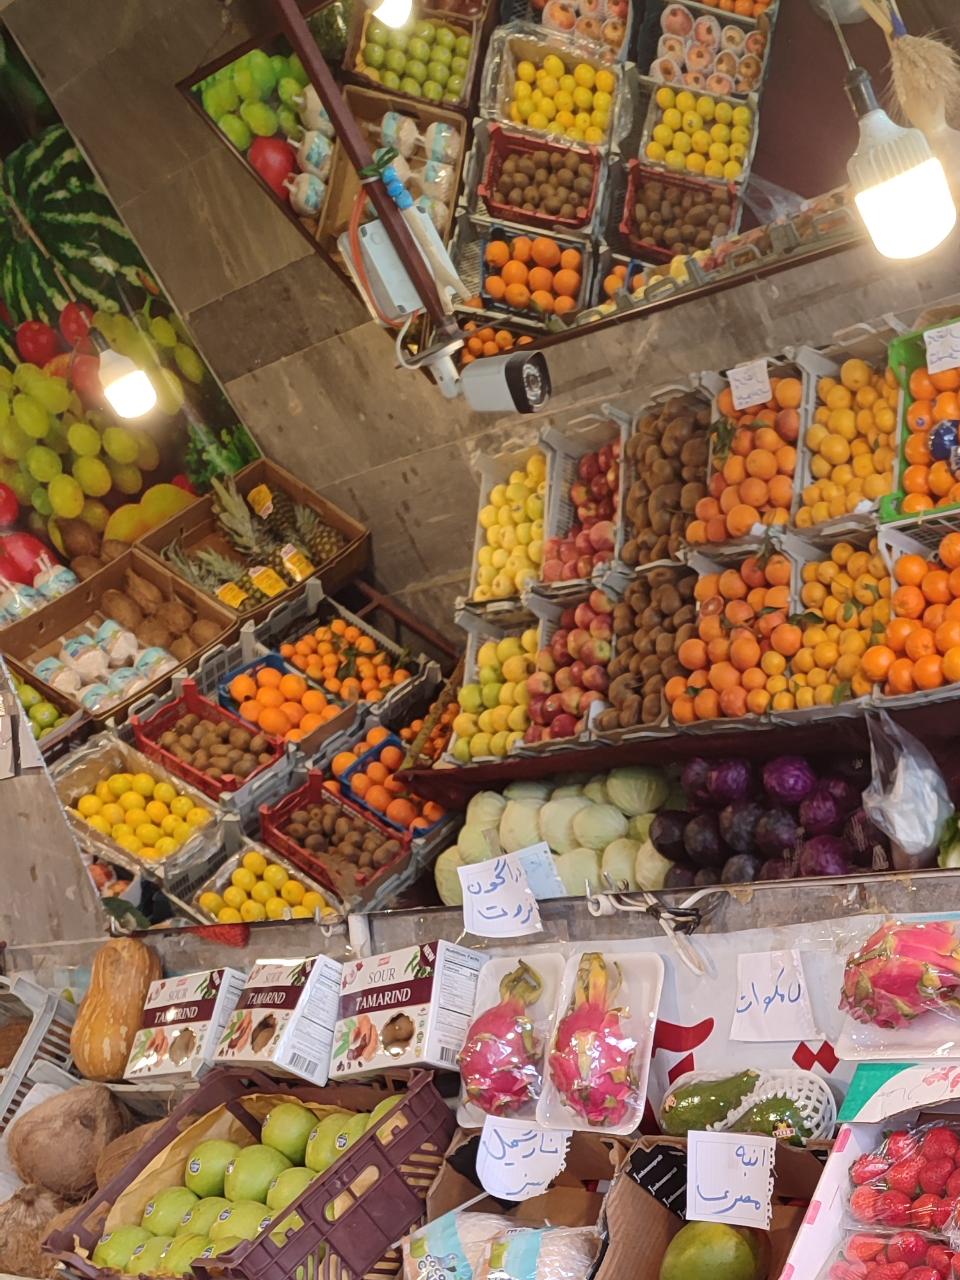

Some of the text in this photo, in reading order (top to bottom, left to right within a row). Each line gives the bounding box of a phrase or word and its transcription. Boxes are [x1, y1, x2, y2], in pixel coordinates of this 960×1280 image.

[367, 968, 396, 984] SOUR
[247, 992, 287, 1004] TAMARIND
[355, 988, 411, 1011] TAMARIND
[736, 1145, 766, 1177] انبه
[697, 1184, 760, 1214] مصری
